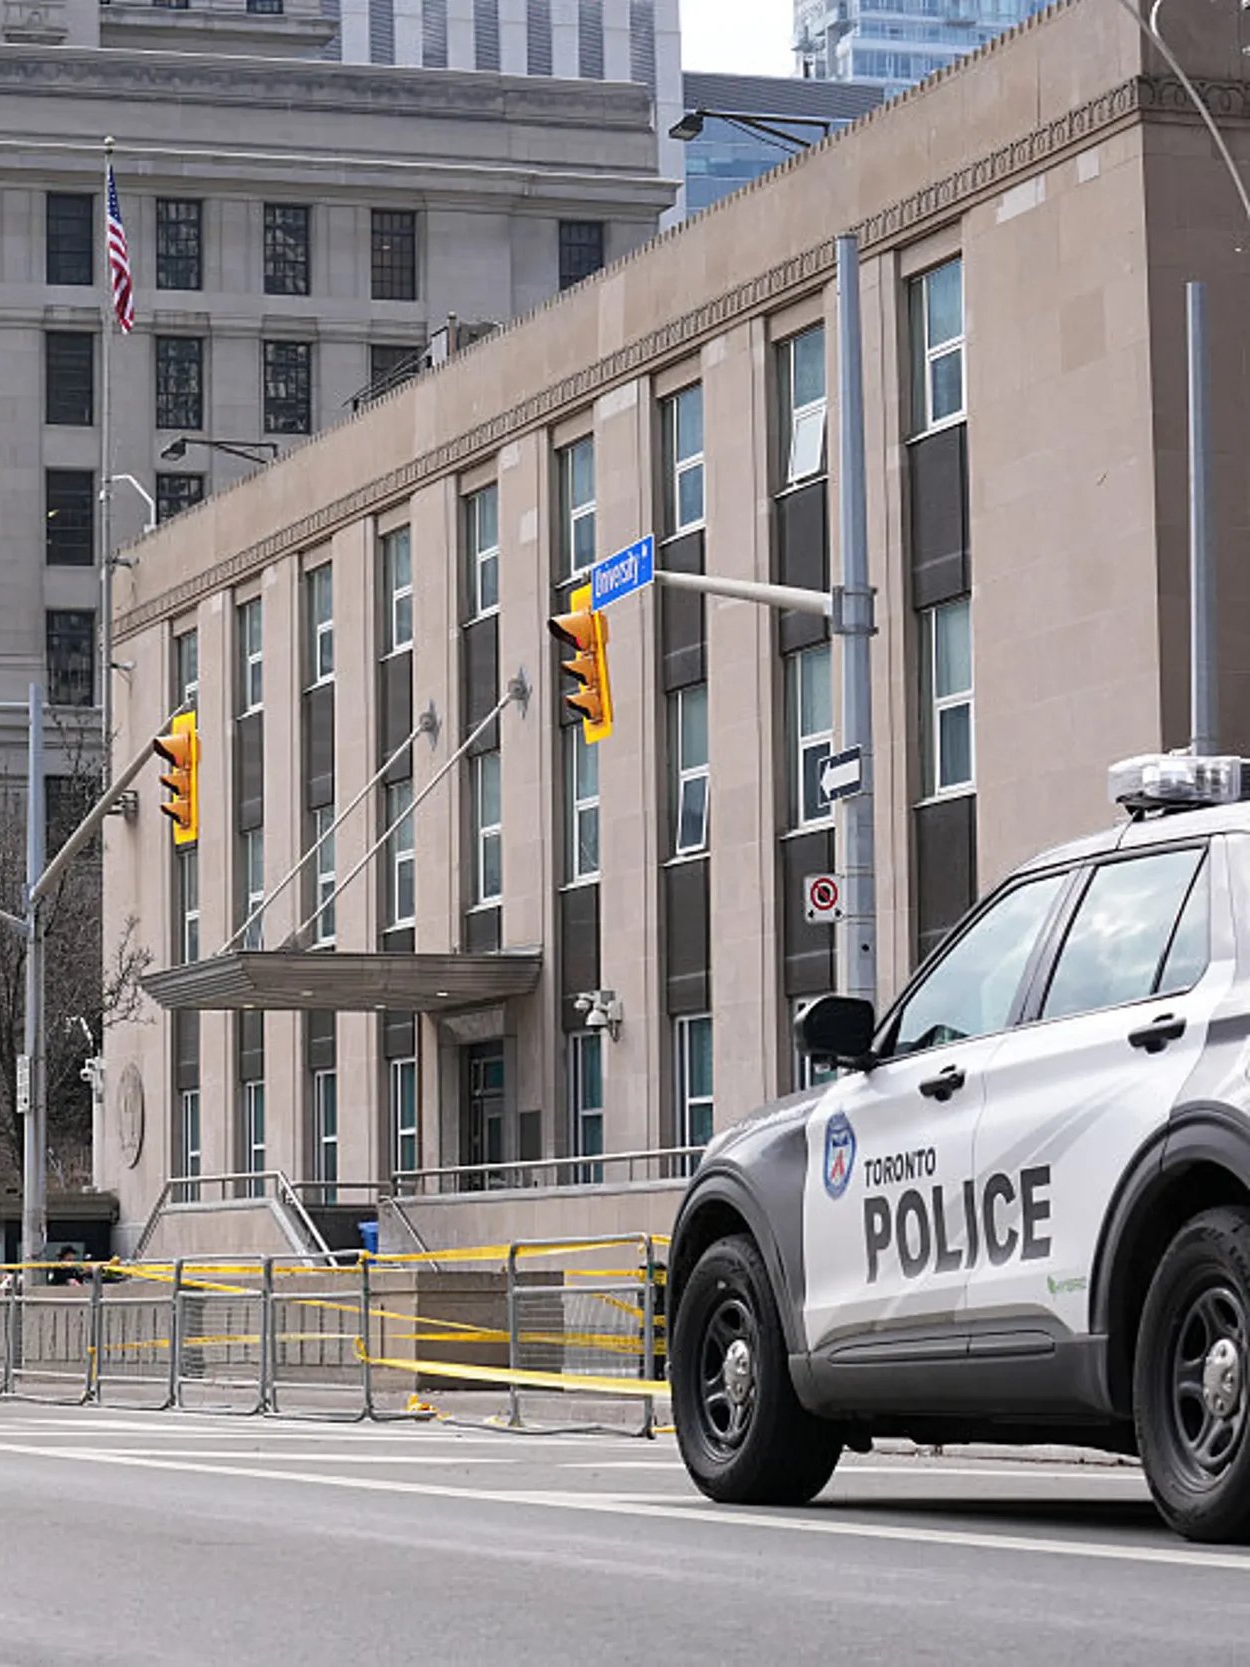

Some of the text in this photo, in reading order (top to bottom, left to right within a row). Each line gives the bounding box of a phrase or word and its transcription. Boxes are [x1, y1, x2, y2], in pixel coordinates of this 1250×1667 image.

[595, 551, 638, 598] University
[864, 1147, 936, 1187] TORONTO
[864, 1165, 1051, 1283] POLICE
